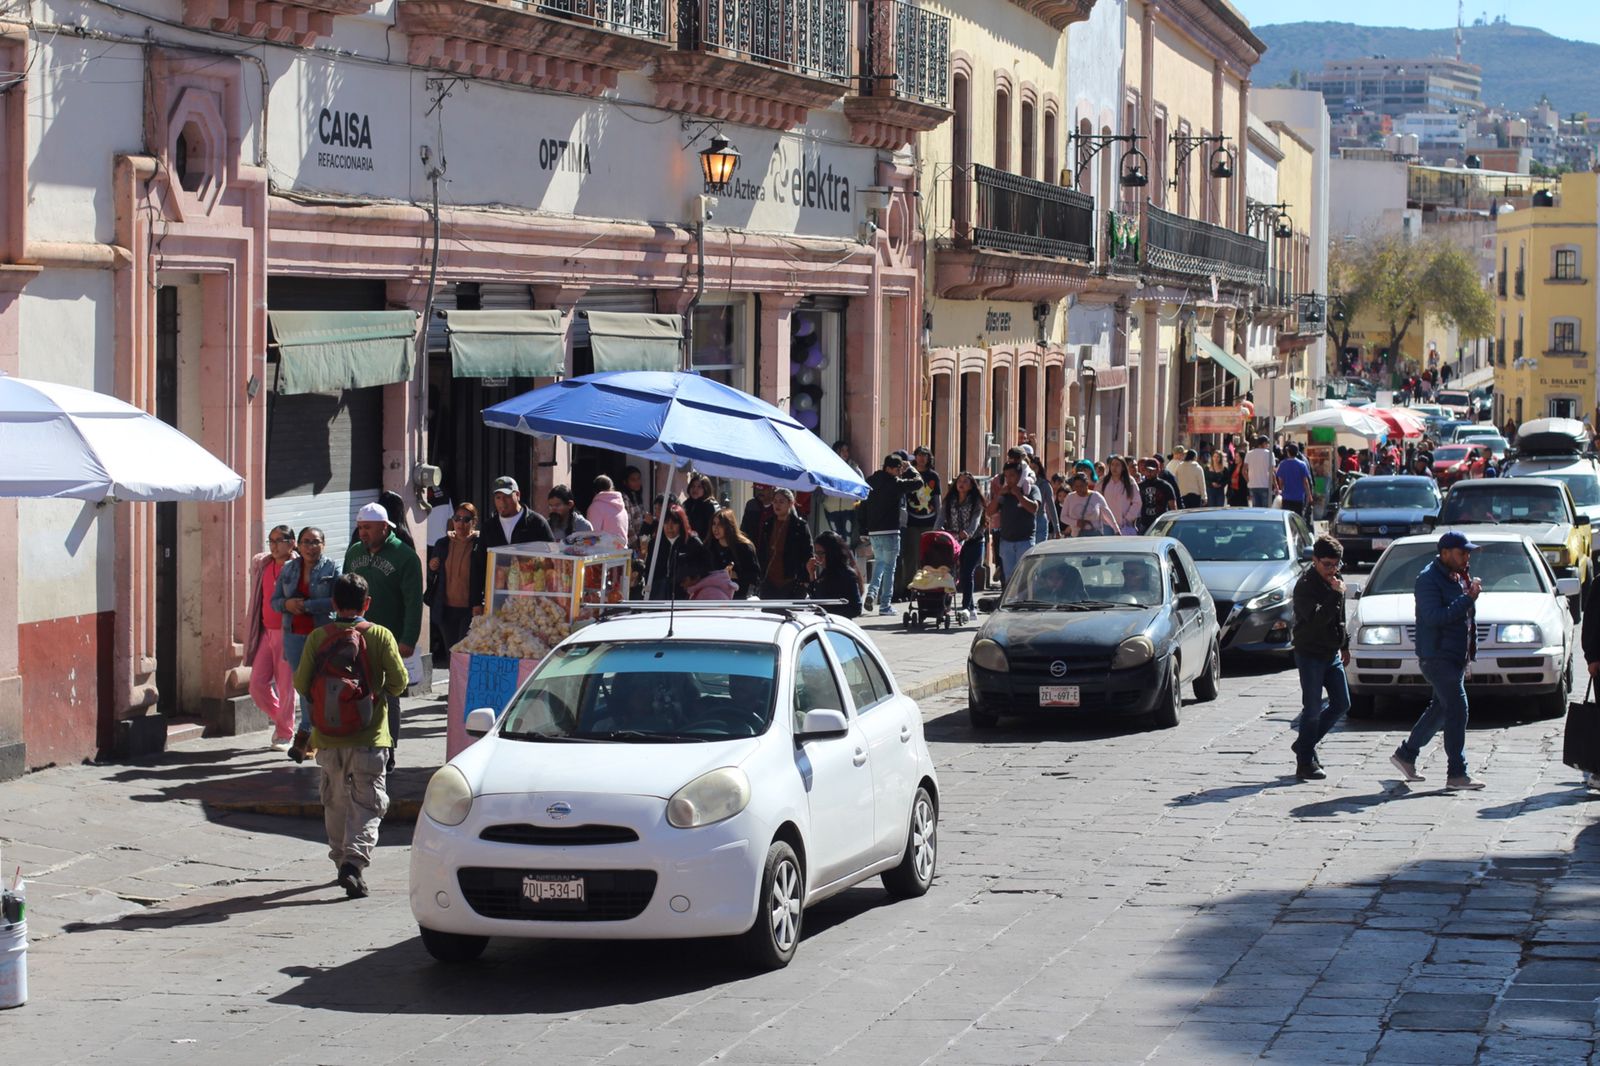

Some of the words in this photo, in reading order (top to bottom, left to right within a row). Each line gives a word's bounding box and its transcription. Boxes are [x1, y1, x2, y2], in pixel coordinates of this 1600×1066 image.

[318, 107, 372, 150] CAISA
[317, 151, 375, 171] REFACCIONARIA
[539, 138, 592, 175] OPTIMA
[733, 177, 767, 201] Azteca
[791, 153, 851, 213] elektra
[1041, 690, 1078, 702] ZEL-697-E
